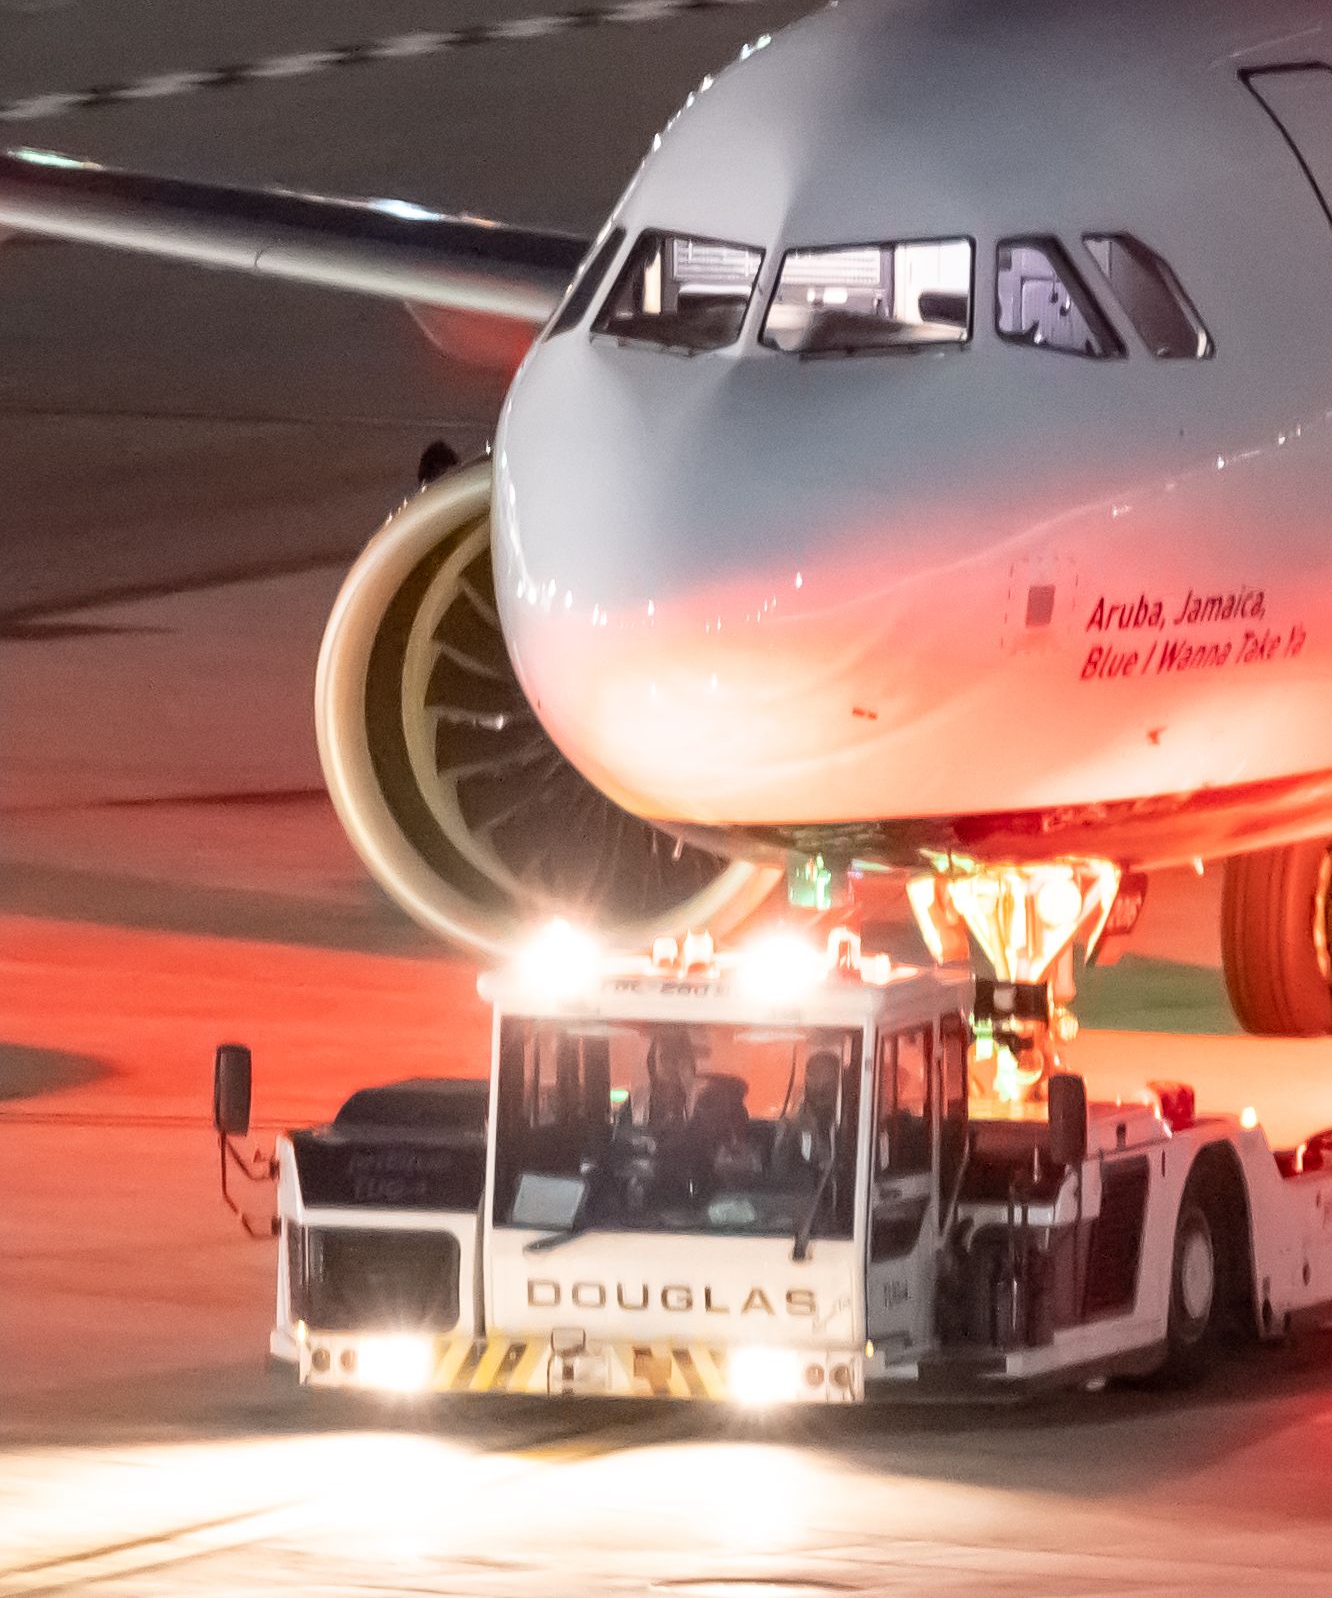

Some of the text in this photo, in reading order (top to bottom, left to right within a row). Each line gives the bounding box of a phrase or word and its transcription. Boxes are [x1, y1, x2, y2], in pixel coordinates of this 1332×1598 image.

[1085, 584, 1267, 633] Aruba, Jamaica,
[1080, 640, 1139, 681] Blue
[1157, 638, 1233, 675] Wanna
[1235, 627, 1281, 665] Take
[527, 1278, 816, 1316] DOUGLAS
